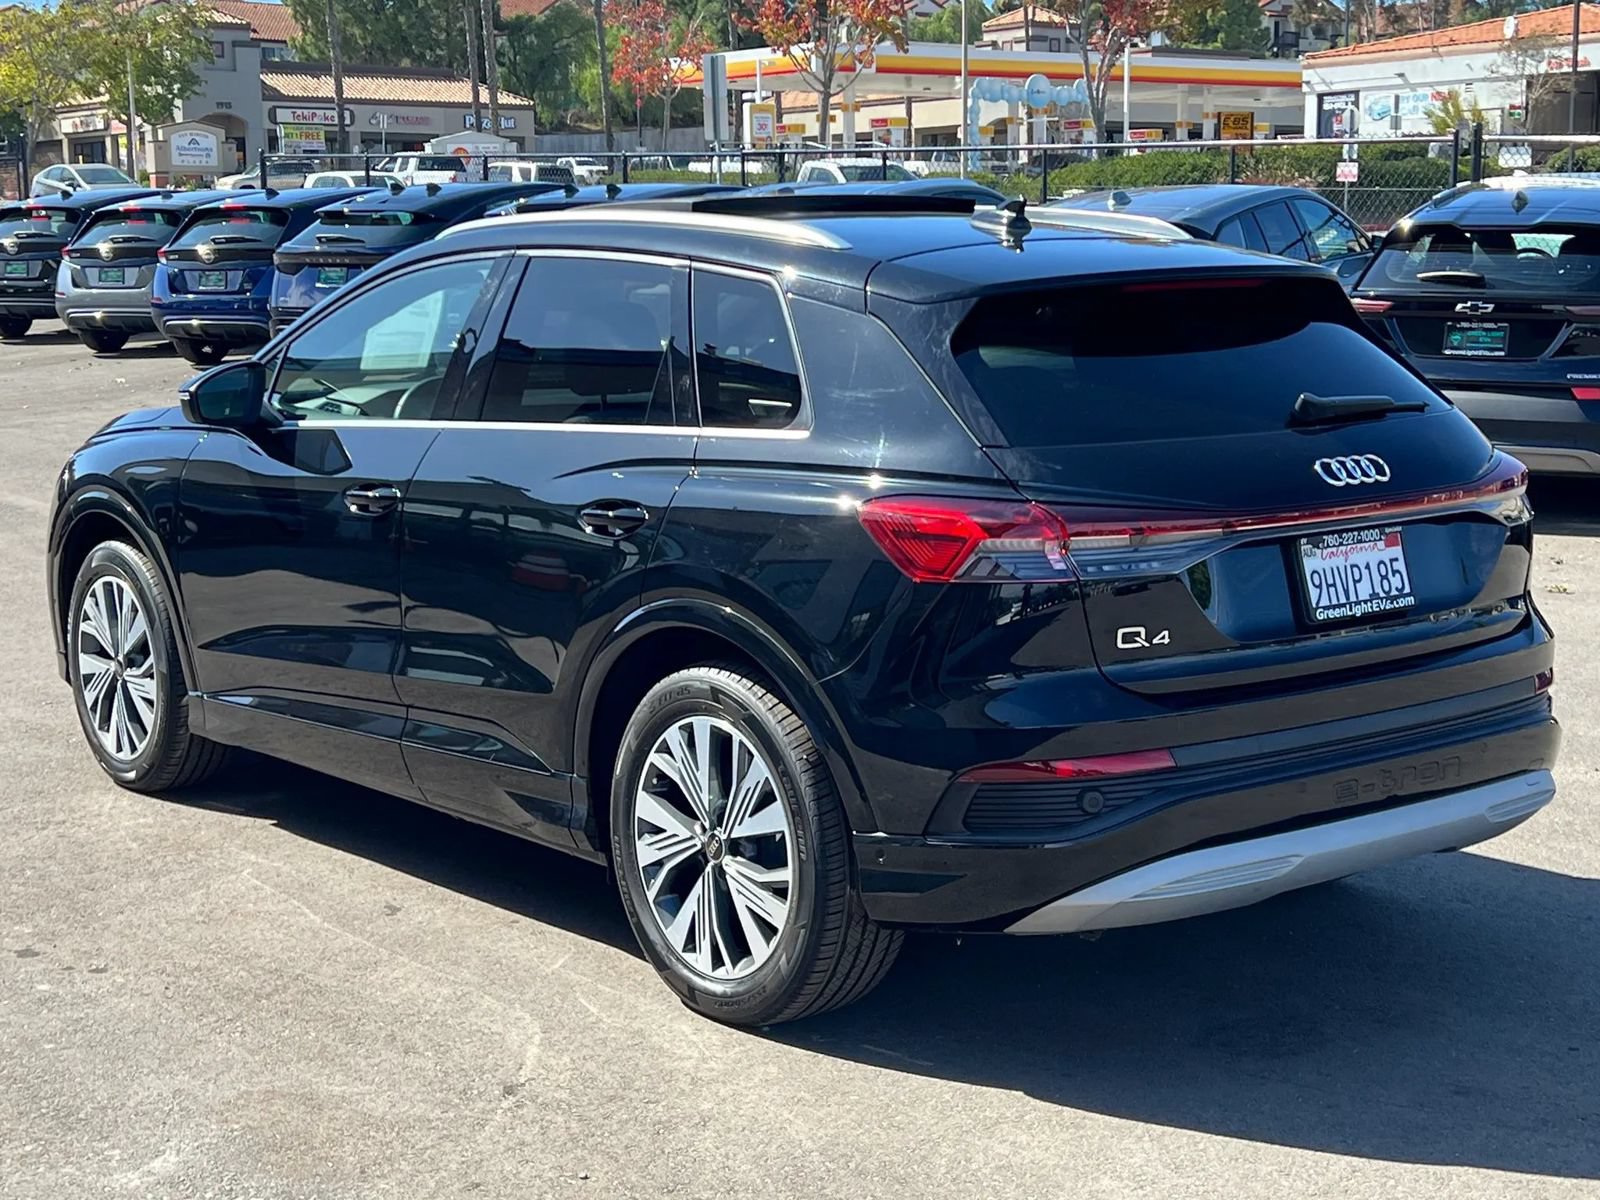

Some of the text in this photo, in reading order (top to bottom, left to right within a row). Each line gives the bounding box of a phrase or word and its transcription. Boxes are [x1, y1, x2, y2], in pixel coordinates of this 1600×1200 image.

[463, 113, 492, 129] Piza
[1323, 529, 1380, 546] 760-227-1000
[1320, 541, 1386, 562] California
[1310, 557, 1406, 607] 9HVP185
[1316, 596, 1415, 620] GreenLightEVs.com
[1116, 626, 1171, 649] Q4
[1332, 755, 1462, 803] e-tron
